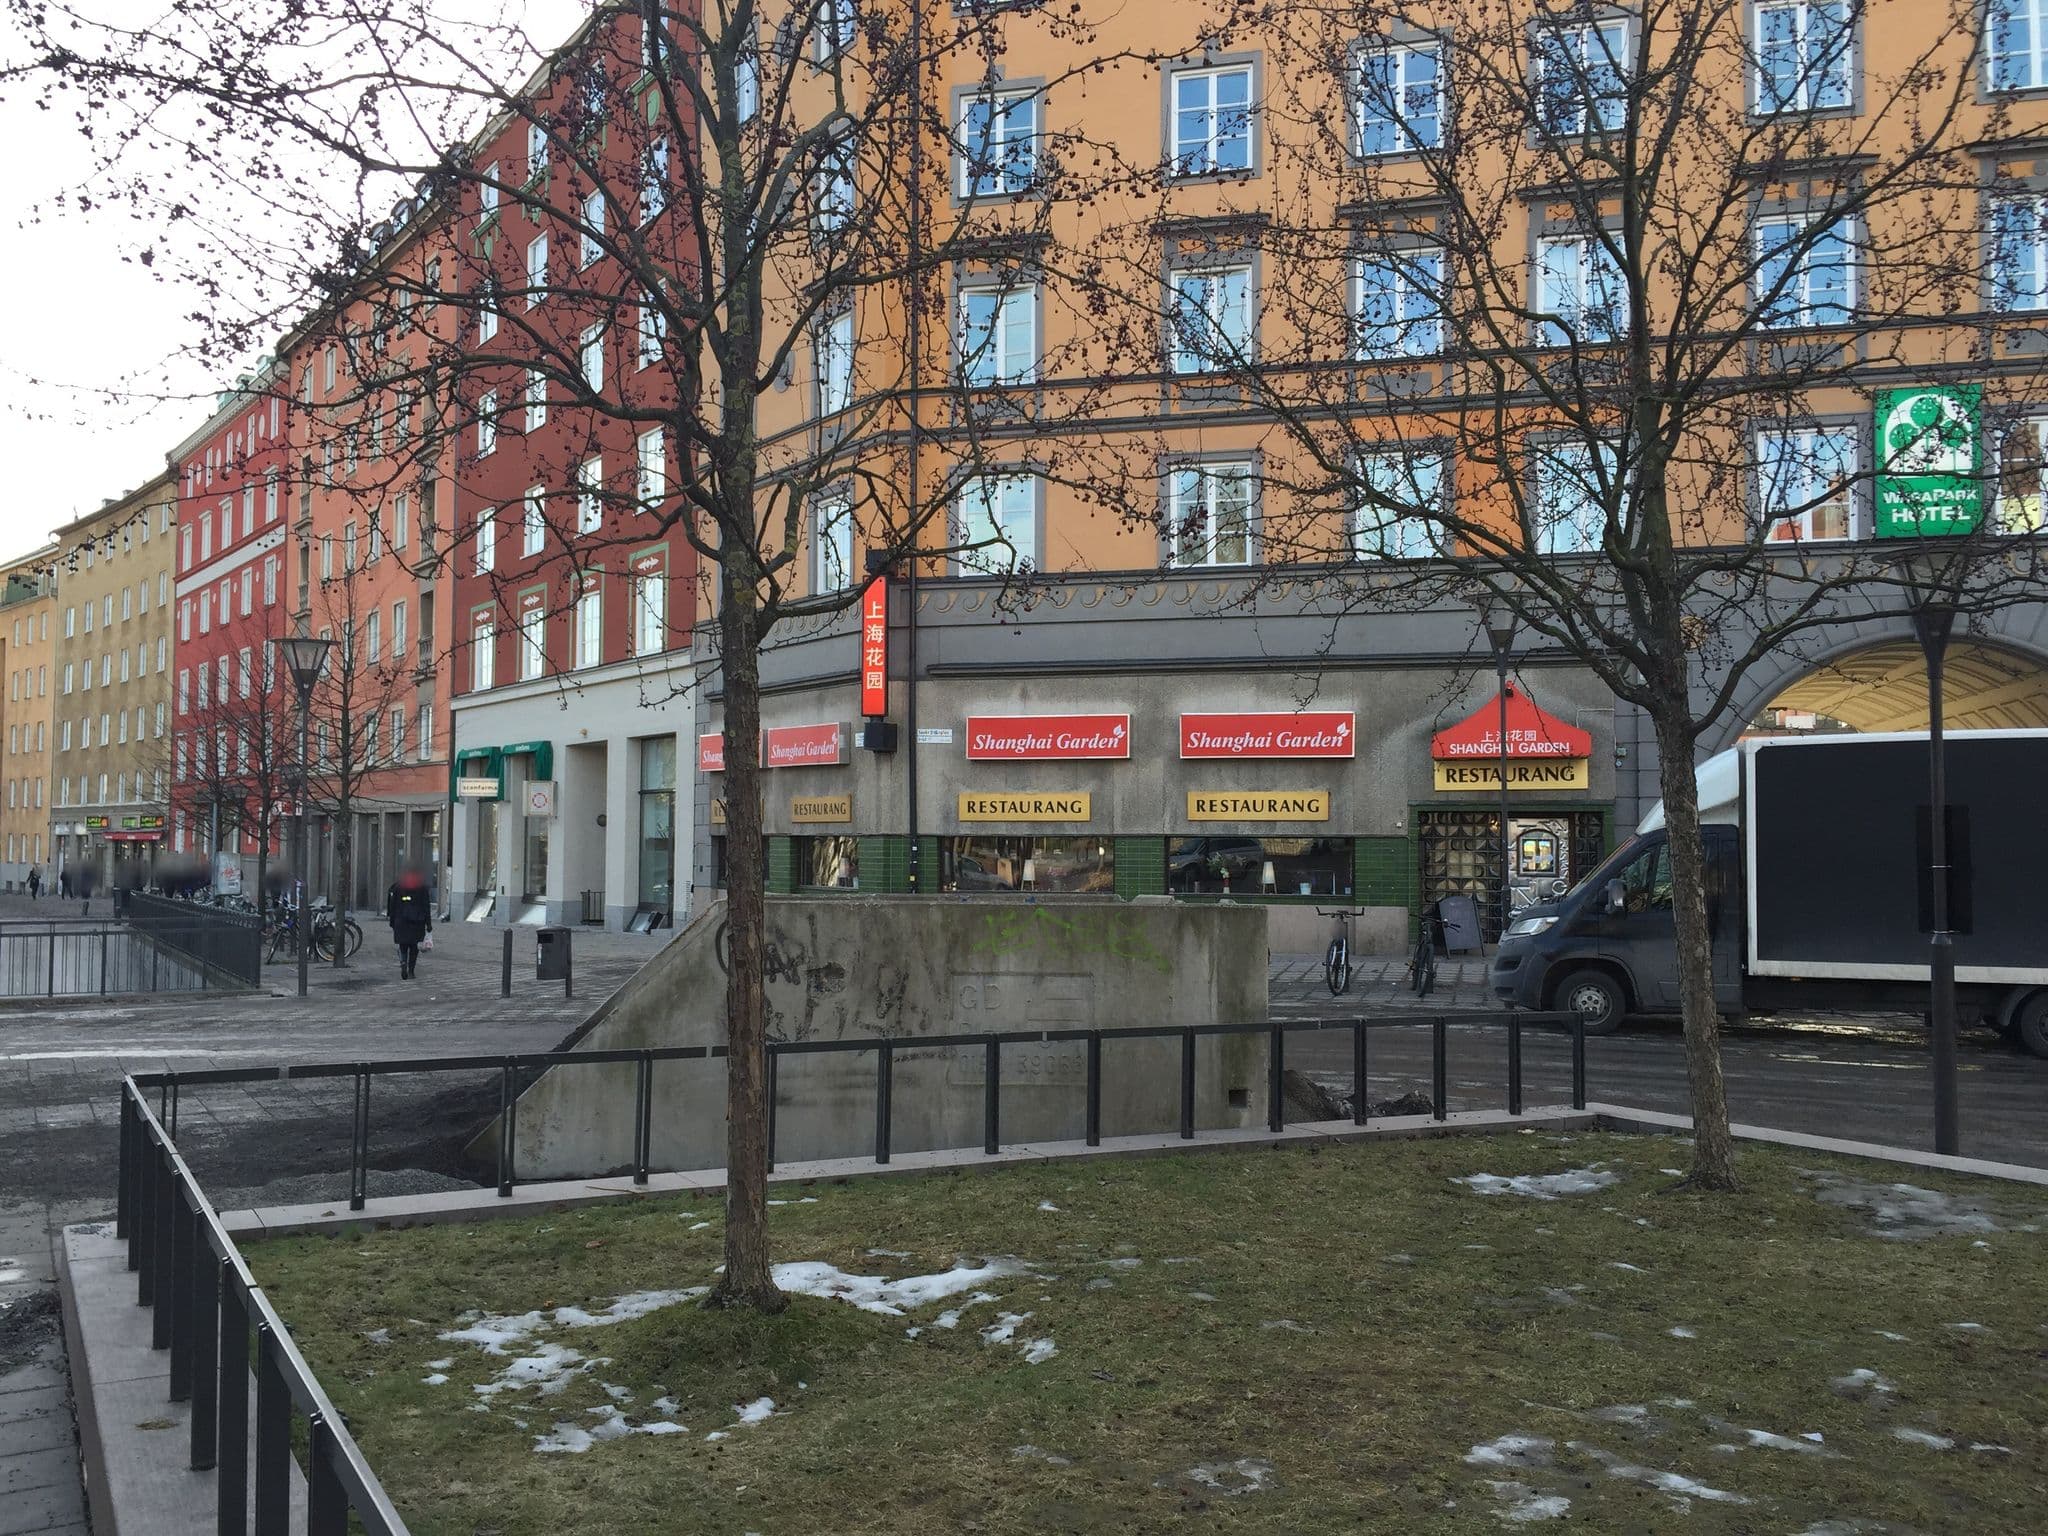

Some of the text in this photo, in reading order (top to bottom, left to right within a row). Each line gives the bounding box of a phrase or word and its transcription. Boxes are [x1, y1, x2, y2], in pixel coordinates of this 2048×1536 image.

[1892, 505, 1971, 523] HOTEL
[866, 601, 884, 690] 上海花园
[973, 733, 1120, 753] Shanghai Garden
[1187, 731, 1343, 752] Shanghai Garden
[1518, 741, 1570, 753] GARDEN
[771, 741, 836, 761] Shanghai Garden
[1445, 765, 1575, 783] RESTAURANG
[793, 802, 847, 816] RESTAURANG
[967, 800, 1082, 814] RESTAURANG
[1196, 799, 1320, 813] RESTAURANG
